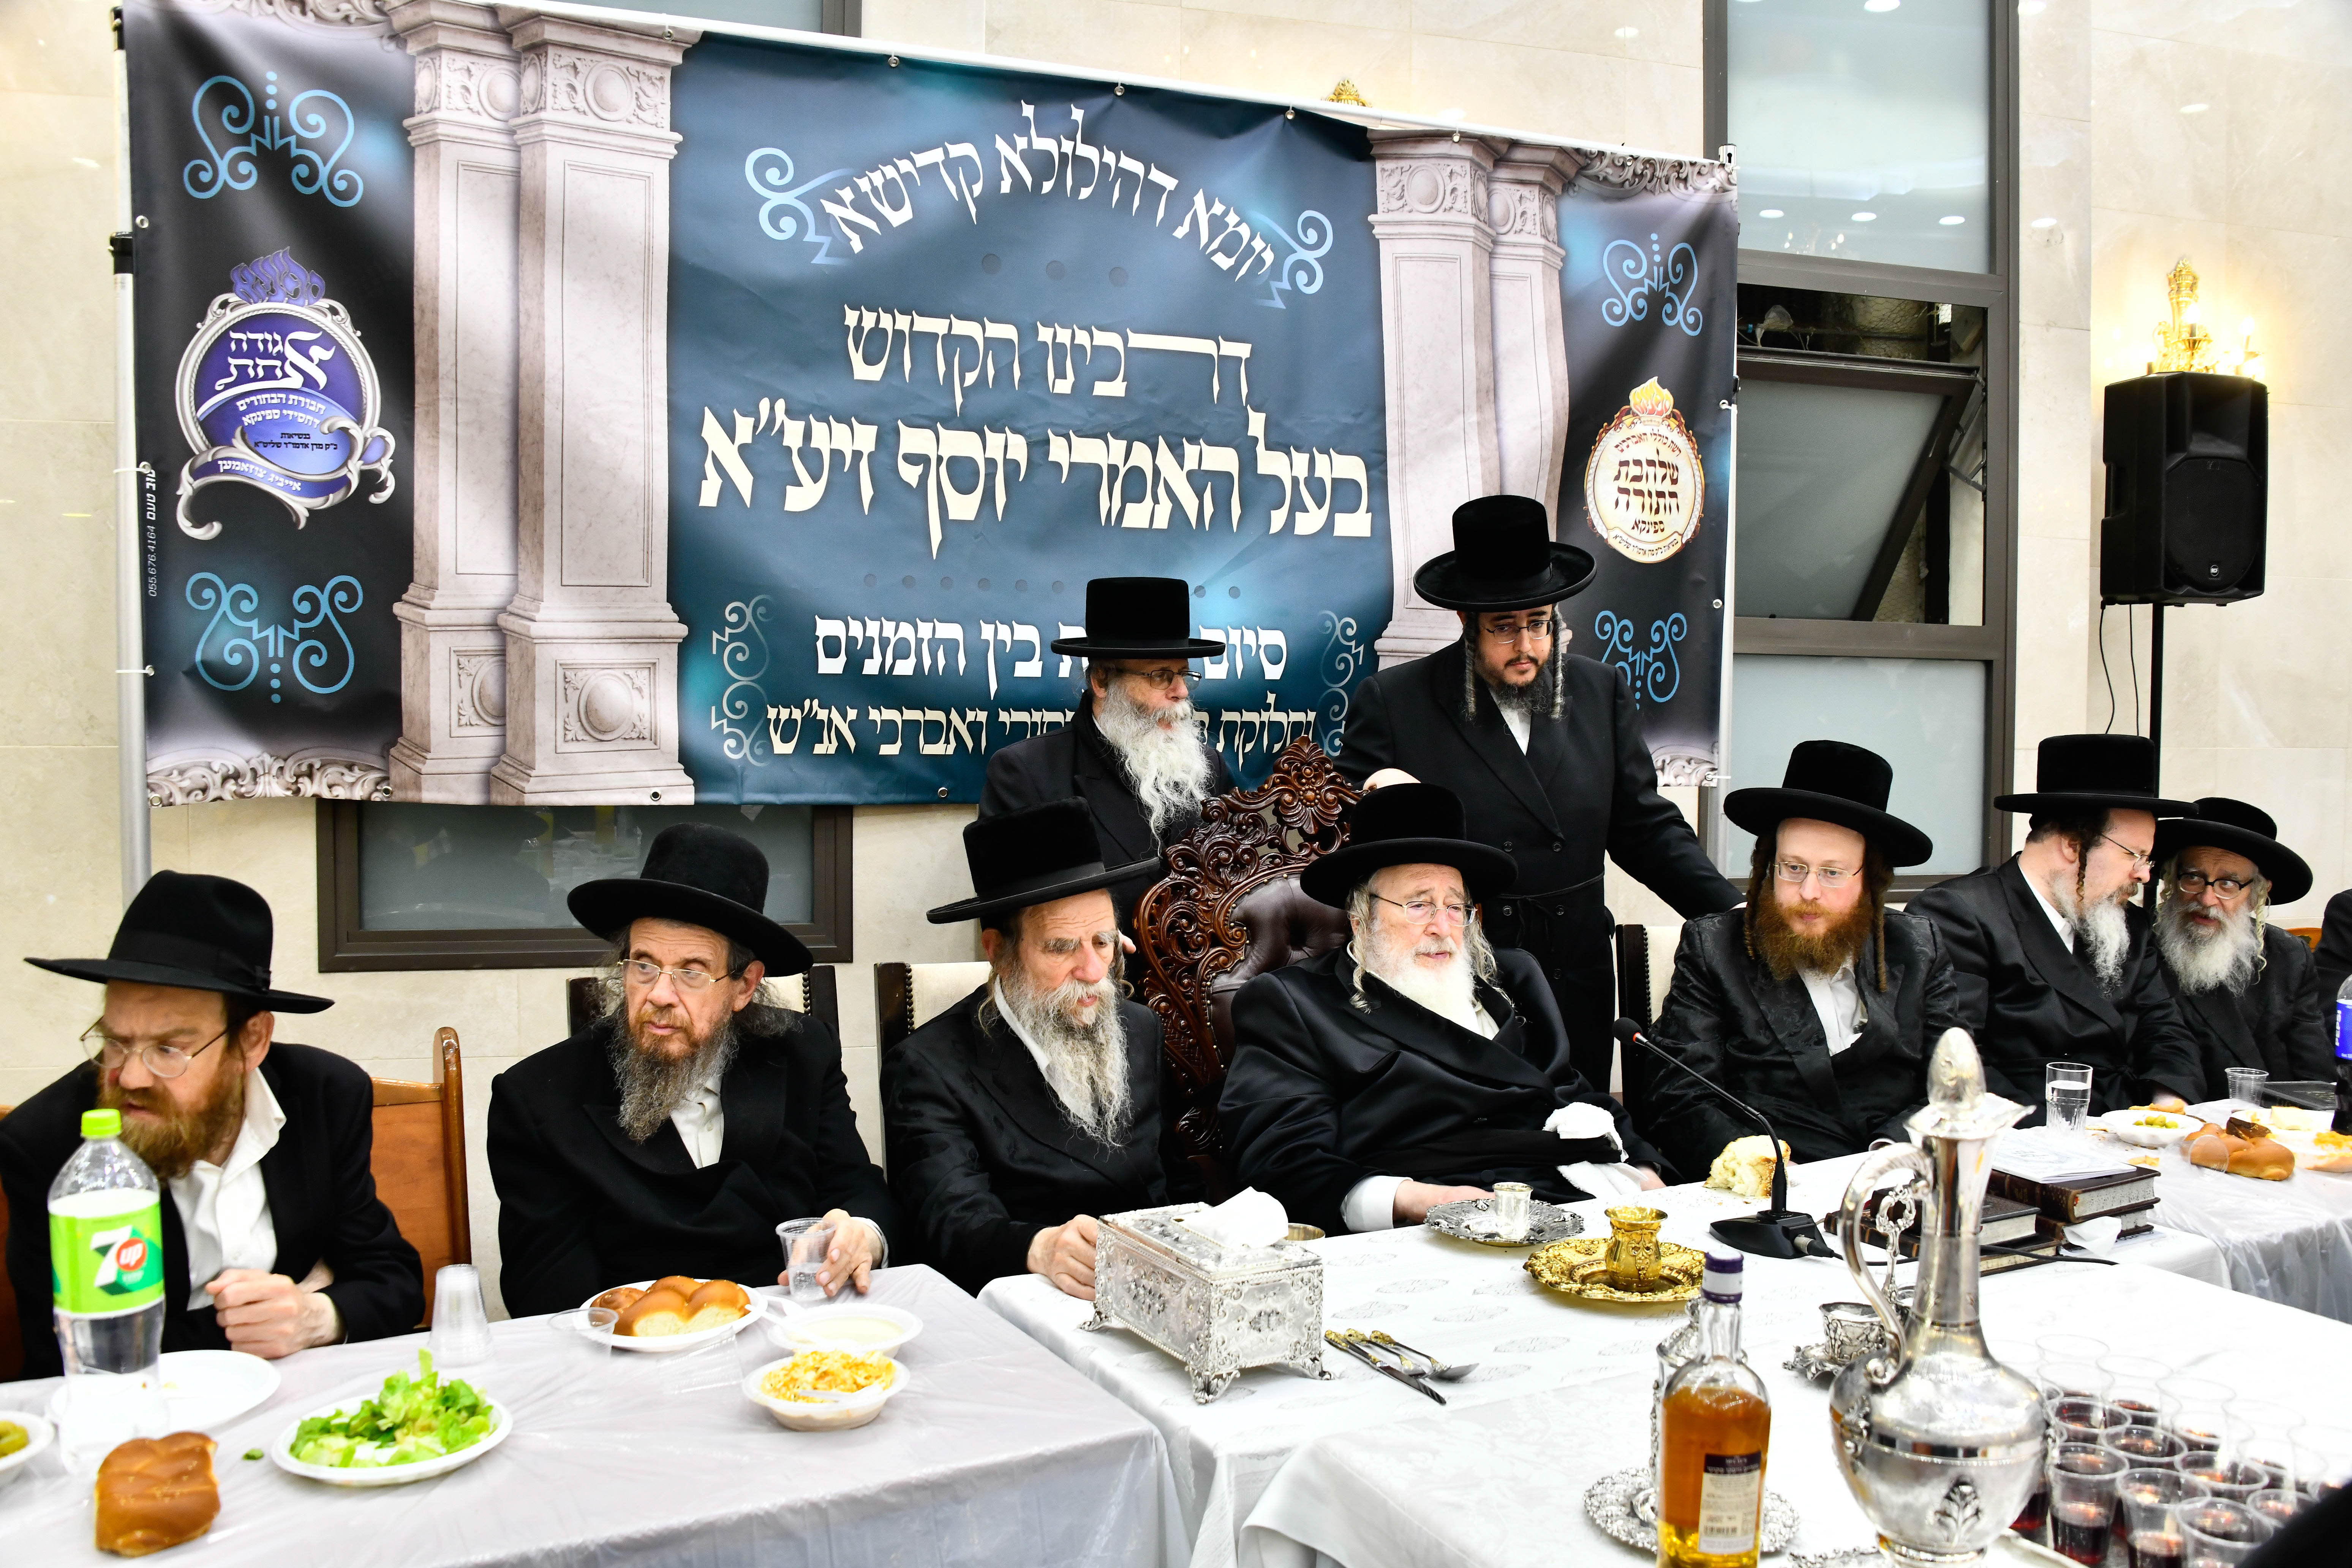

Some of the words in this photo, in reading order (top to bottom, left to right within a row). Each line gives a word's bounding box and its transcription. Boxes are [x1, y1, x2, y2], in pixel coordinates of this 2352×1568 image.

[996, 100, 1178, 227] דהילולא
[820, 142, 983, 254] קדישא
[1173, 189, 1274, 281] יומא
[844, 304, 1020, 417] הקדוש
[1037, 321, 1252, 406] דרבינו
[236, 394, 286, 411] הבחורים
[242, 409, 280, 426] ספינקא
[282, 409, 321, 428] דחסידי
[288, 394, 326, 414] חבורת
[311, 443, 323, 451] מרן
[699, 398, 877, 515] זיע"א
[1614, 433, 1648, 453] האברכים
[1650, 428, 1669, 445] כוללי
[1668, 439, 1681, 457] רשת
[218, 460, 267, 478] צוזאמען
[267, 474, 301, 491] אייביג
[898, 419, 1027, 560] יוסף
[1048, 428, 1241, 532] האמרי
[1247, 405, 1372, 537] בעל
[1614, 446, 1679, 485] שלהבת
[146, 494, 156, 520] טעם
[1614, 485, 1679, 515] התורה
[1631, 517, 1665, 535] ספינקא
[147, 525, 157, 597] 055.676.4164
[815, 615, 966, 675] הזמנים
[980, 620, 1042, 700] בין
[1199, 624, 1287, 680] סיום
[767, 699, 857, 754] אנ"ש
[869, 706, 988, 754] ואברכי
[998, 689, 1084, 739] חורי
[1216, 690, 1317, 772] וחלוקת
